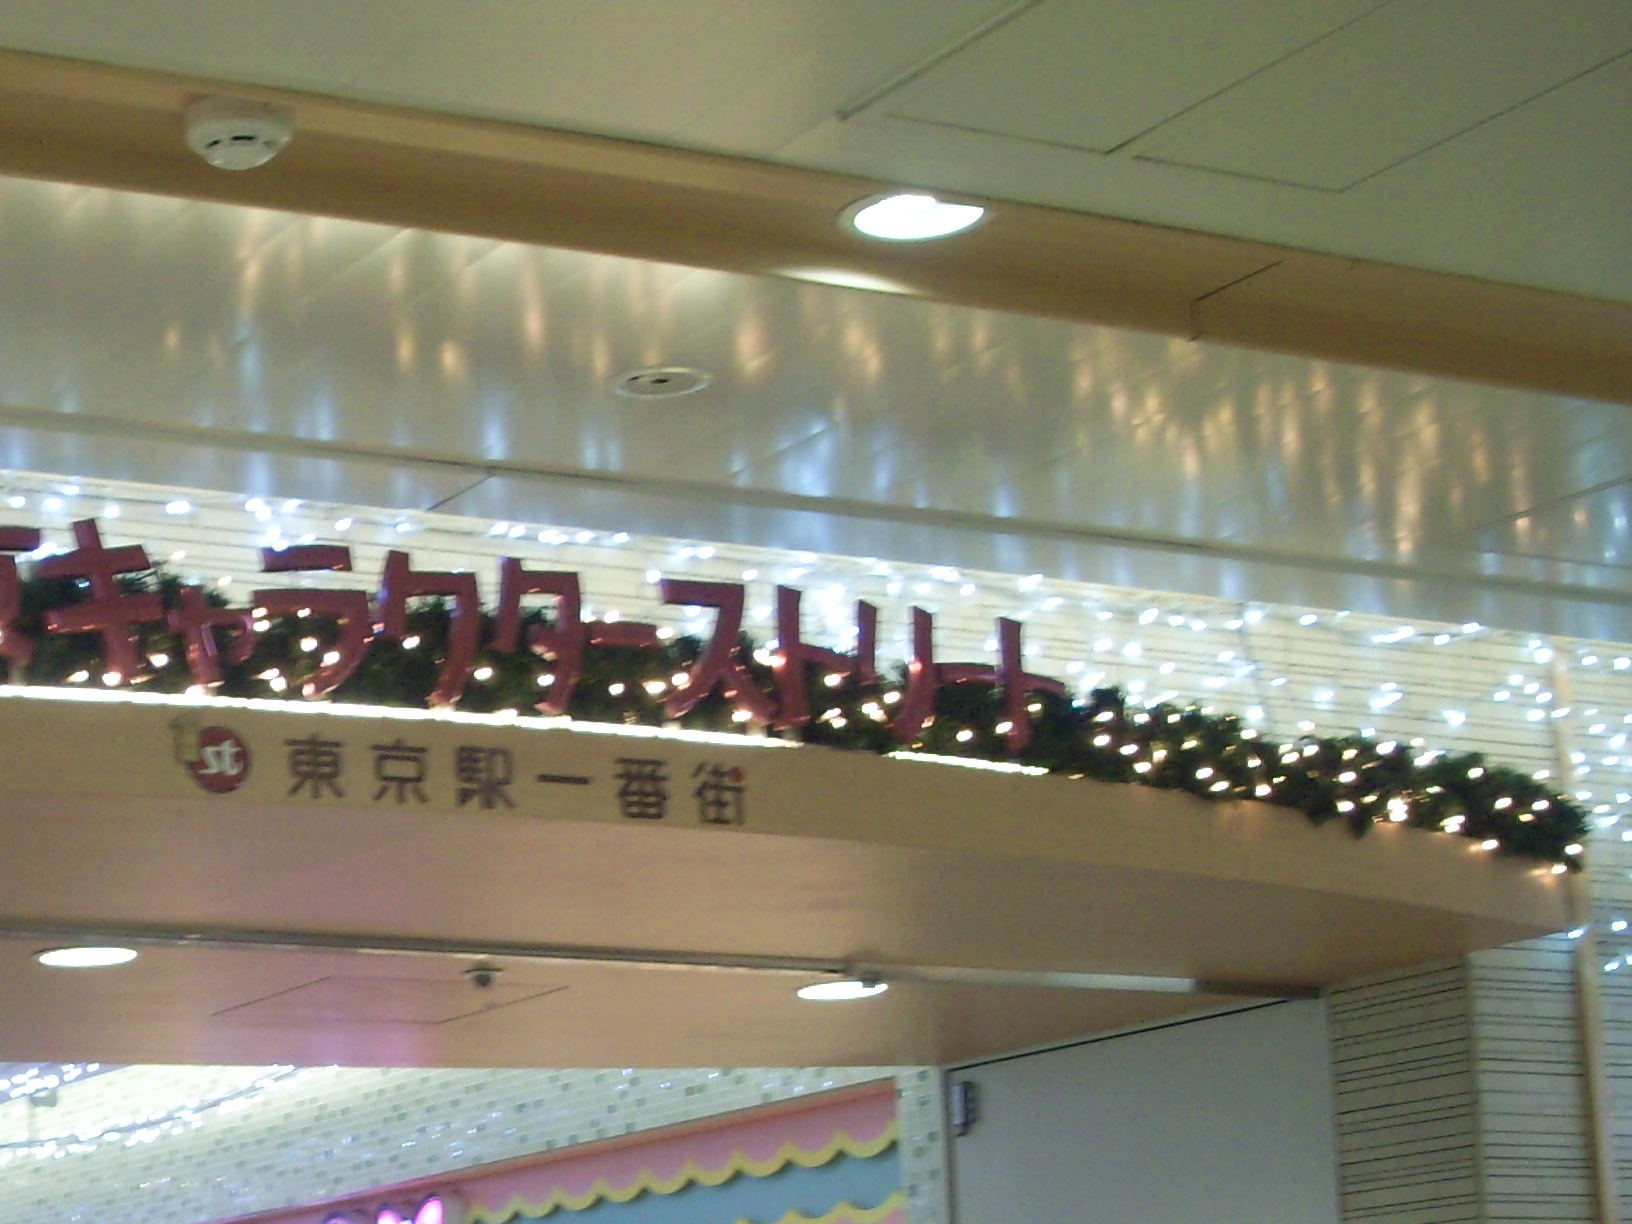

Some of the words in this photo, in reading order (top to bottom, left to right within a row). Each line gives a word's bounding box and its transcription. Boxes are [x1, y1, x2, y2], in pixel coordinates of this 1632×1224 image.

[284, 733, 747, 826] 東京駅一番街
